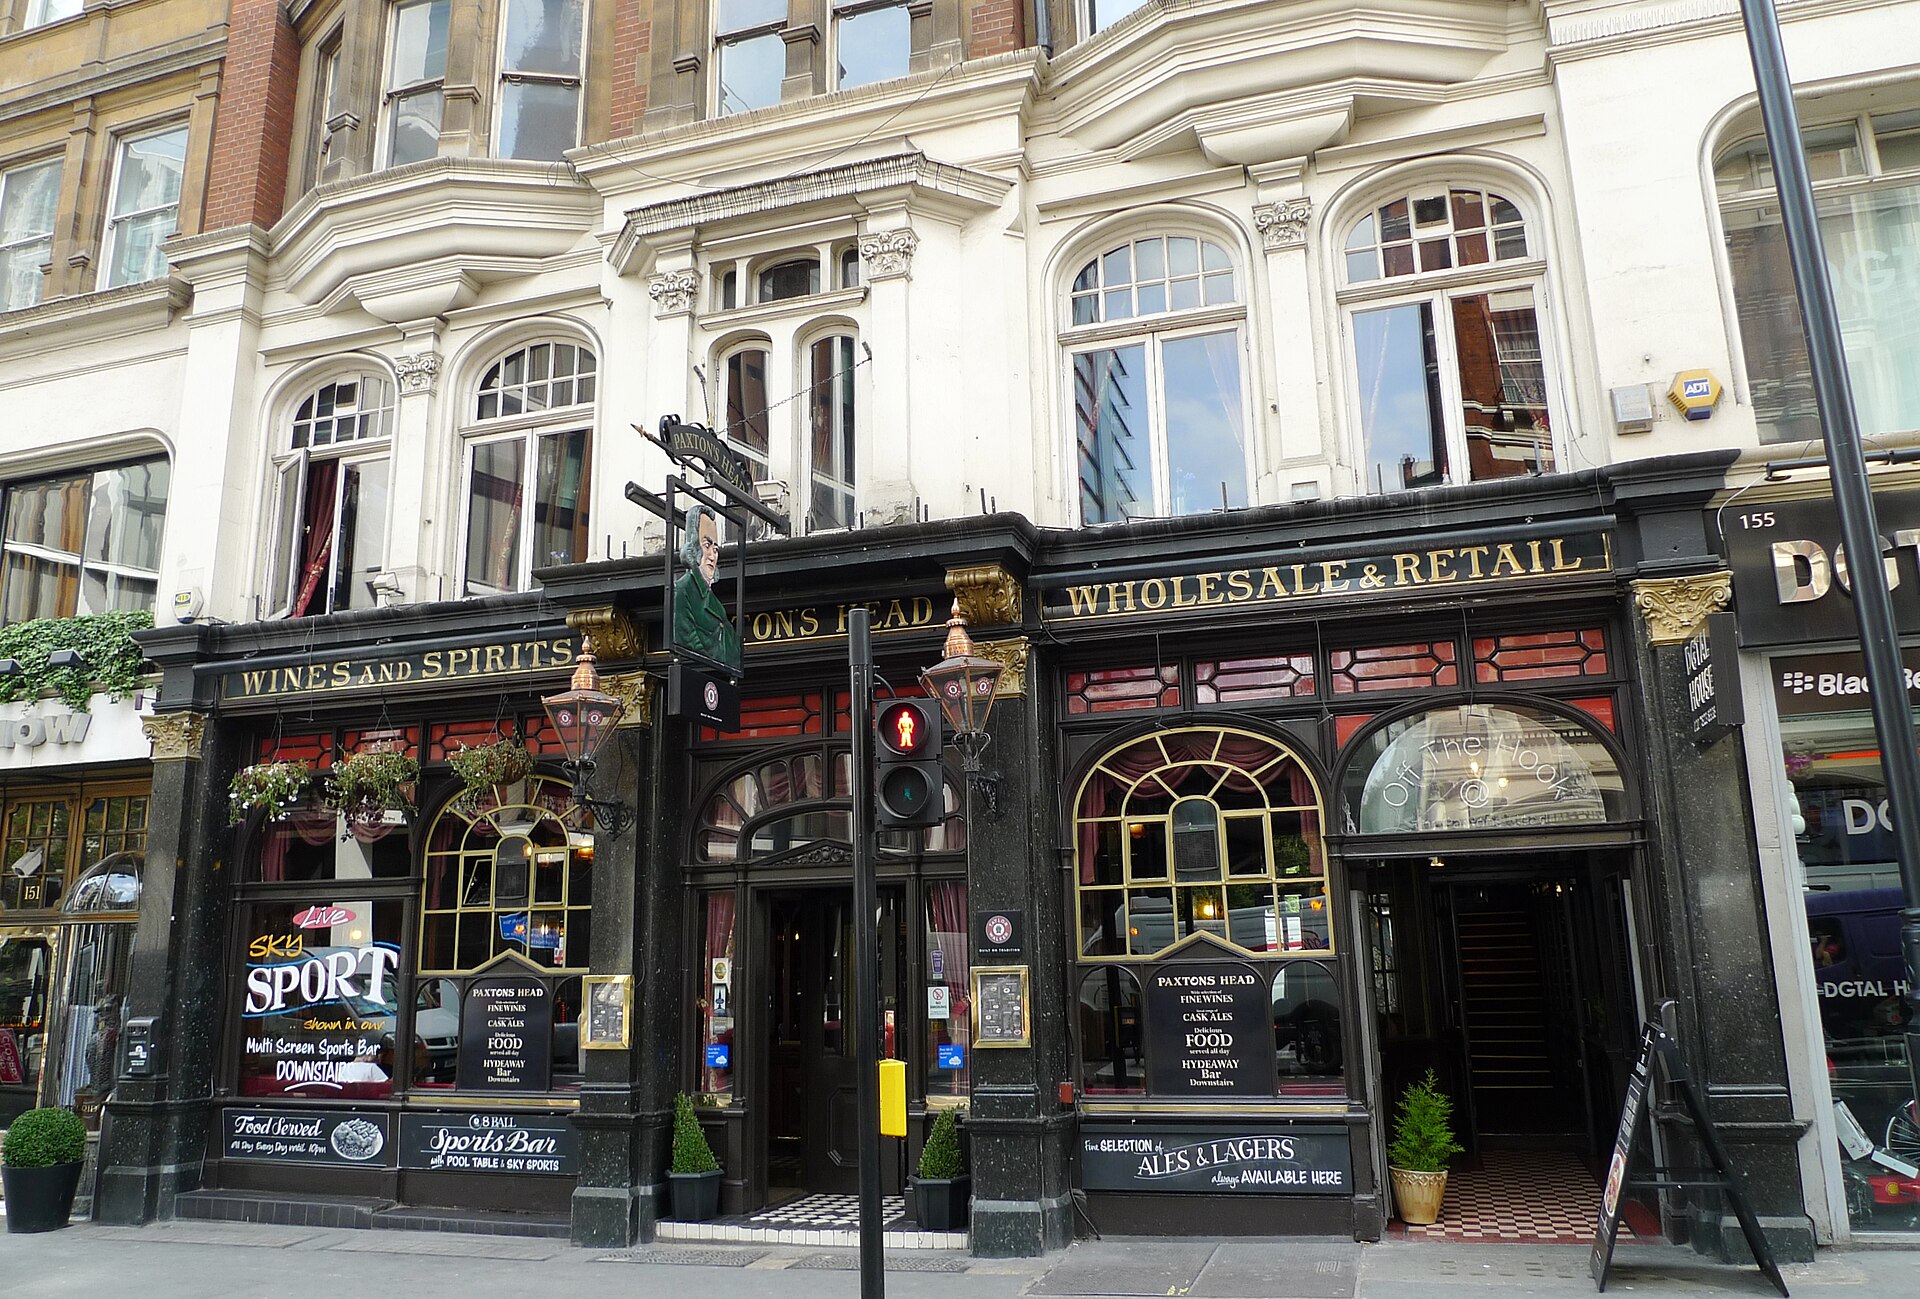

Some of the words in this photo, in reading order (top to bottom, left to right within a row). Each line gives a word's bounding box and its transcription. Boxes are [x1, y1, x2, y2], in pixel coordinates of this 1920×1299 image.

[1684, 382, 1709, 394] ADT
[673, 432, 720, 463] PAXTON'S
[1740, 512, 1775, 529] 155
[1066, 560, 1350, 615] WHOLESALE
[1359, 563, 1387, 589] &
[1392, 538, 1582, 586] RETAIL
[836, 596, 934, 633] HEAD
[242, 661, 350, 695] WINES
[358, 660, 412, 684] AND
[421, 638, 573, 678] SPIRITS
[1689, 664, 1715, 711] HOUSE
[1383, 760, 1421, 807] Off
[1419, 736, 1481, 764] The
[1496, 734, 1569, 800] Hook
[1460, 778, 1489, 808] @
[24, 885, 40, 900] 151
[299, 905, 348, 929] Live
[249, 933, 303, 958] SKY
[245, 946, 398, 1013] SPORT
[1157, 976, 1216, 987] PAXTONS
[1220, 975, 1255, 985] HEAD
[473, 988, 515, 997] PAXTONS
[518, 988, 544, 997] HEAD
[1180, 995, 1202, 1004] FINE
[1204, 994, 1234, 1003] WINES
[503, 1004, 527, 1012] WINES
[303, 1016, 341, 1031] shown
[344, 1016, 356, 1031] in
[361, 1020, 385, 1031] our
[507, 1019, 525, 1027] ALES
[1182, 1013, 1208, 1021] CASK
[1210, 1012, 1233, 1021] ALES
[246, 1037, 273, 1054] Multi
[276, 1038, 315, 1055] Screen
[318, 1038, 354, 1060] Sports
[357, 1039, 381, 1056] Bar
[488, 1038, 523, 1049] FOOD
[1185, 1034, 1233, 1047] FOOD
[1219, 1048, 1230, 1056] day
[276, 1060, 355, 1083] DOWNSTAIR
[483, 1060, 526, 1068] HYDEAWAY
[496, 1068, 512, 1076] Bar
[1182, 1060, 1240, 1069] HYDEAWAY
[1201, 1069, 1222, 1079] Bar
[234, 1115, 273, 1135] Food
[271, 1116, 323, 1137] Served
[482, 1116, 490, 1128] 8
[491, 1116, 517, 1128] BALL
[230, 1141, 241, 1149] All
[241, 1140, 254, 1153] Day
[308, 1143, 327, 1156] 10pm
[430, 1128, 504, 1155] Sports
[505, 1130, 557, 1154] Bar
[1084, 1139, 1100, 1152] Fine
[1100, 1139, 1152, 1152] SELECTION
[1154, 1140, 1165, 1156] of
[446, 1155, 470, 1167] POOL
[472, 1157, 499, 1168] TABLE
[506, 1158, 524, 1170] SKY
[526, 1158, 560, 1171] SPORTS
[1137, 1150, 1191, 1176] ALES
[1196, 1149, 1210, 1167] &
[1211, 1138, 1295, 1165] LAGERS
[1211, 1171, 1240, 1189] always
[1240, 1170, 1307, 1185] AVAILABLE
[1311, 1170, 1343, 1185] HERE
